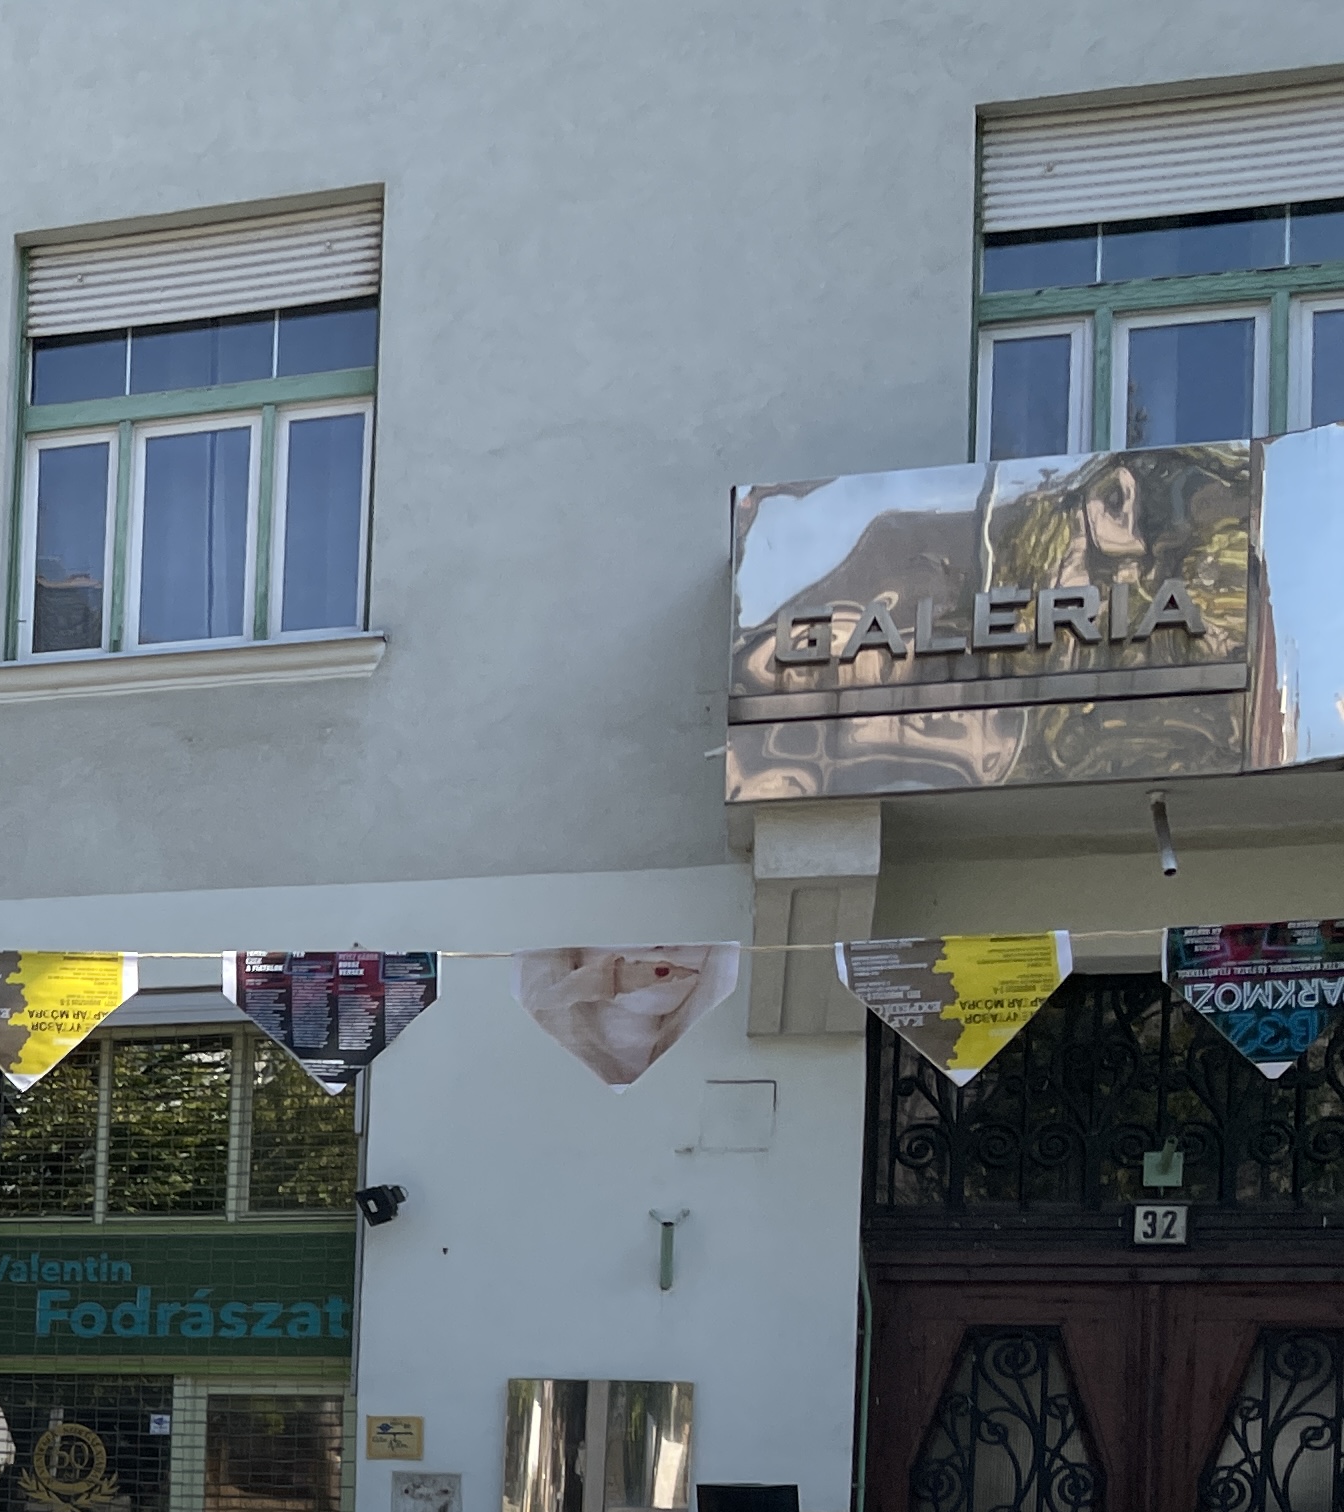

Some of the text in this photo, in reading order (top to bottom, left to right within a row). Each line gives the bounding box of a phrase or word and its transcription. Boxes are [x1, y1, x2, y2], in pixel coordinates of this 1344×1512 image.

[1184, 977, 1344, 1014] ARKMOZI
[1142, 1210, 1178, 1239] 32
[35, 1285, 352, 1340] Fodrászat
